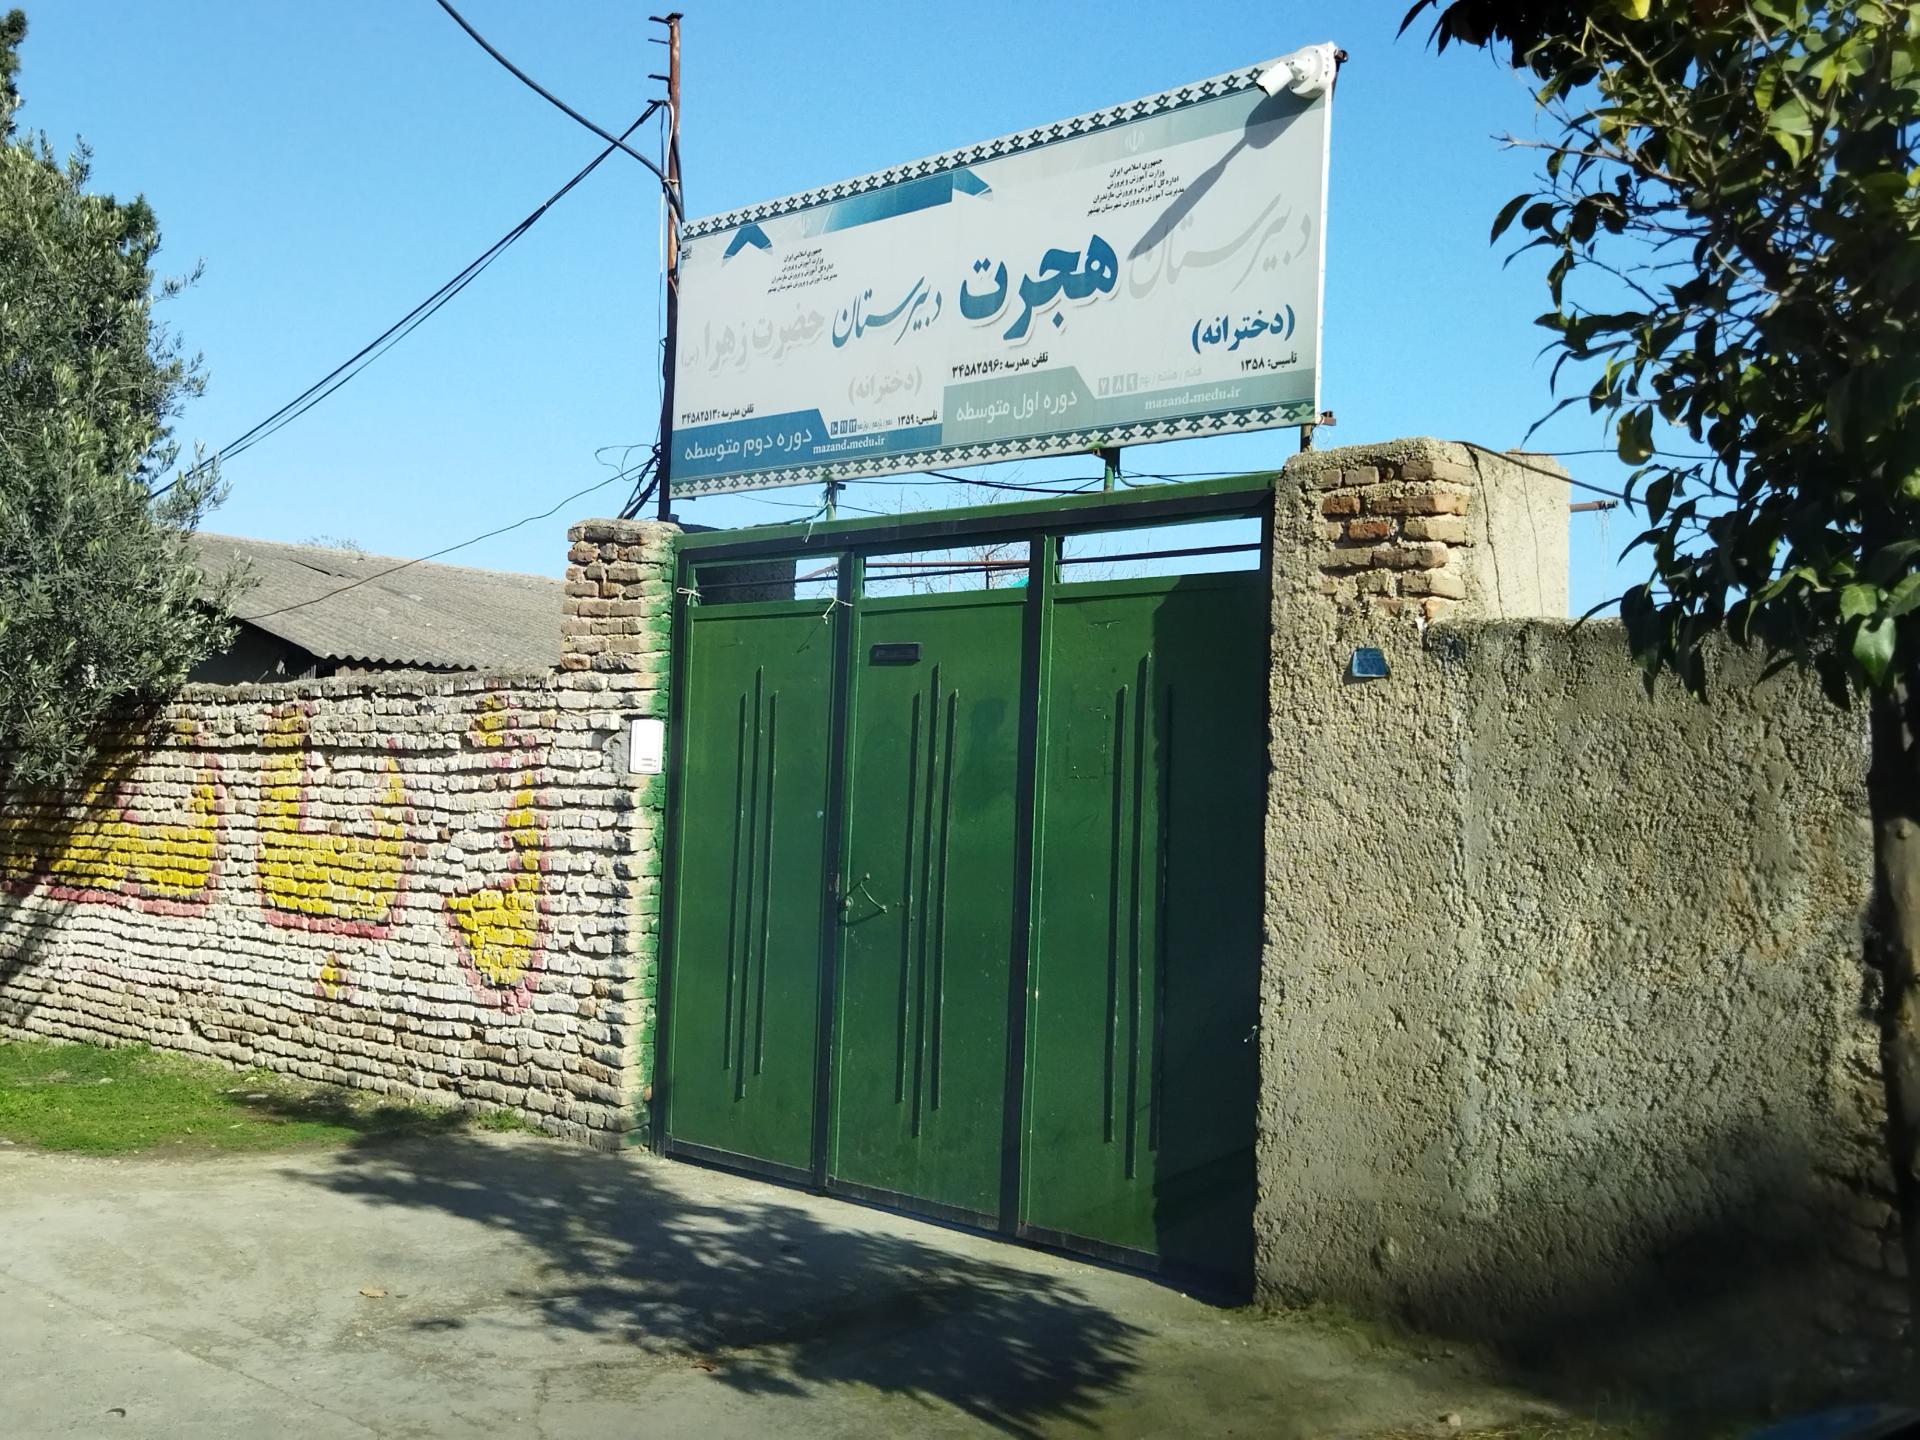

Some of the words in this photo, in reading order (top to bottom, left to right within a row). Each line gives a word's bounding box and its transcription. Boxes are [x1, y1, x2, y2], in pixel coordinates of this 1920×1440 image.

[1109, 167, 1123, 178] ایران
[1123, 163, 1141, 174] اسلامی
[1148, 170, 1165, 178] وزارت
[1107, 179, 1124, 189] پرورش
[1129, 171, 1147, 184] آموزش
[1115, 188, 1133, 198] پرورش
[1138, 180, 1156, 193] آموزش
[1165, 187, 1184, 196] مدیریت
[1092, 192, 1114, 203] مازندران
[1122, 198, 1140, 208] پرورش
[1145, 189, 1163, 202] آموزش
[1101, 203, 1121, 213] شهرستان
[1128, 193, 1311, 299] دبیرستان
[959, 234, 1119, 341] هجرت
[832, 276, 942, 348] دبیرستان
[751, 304, 825, 360] حضرت
[1192, 304, 1295, 354] (دخترانه)
[704, 319, 747, 372] زهرا
[1005, 357, 1030, 371] مدرسه
[1031, 352, 1048, 368] تلفن
[1240, 356, 1265, 371] ۱۳۵۸
[848, 366, 922, 404] (دخترانه)
[1013, 391, 1039, 419] اول
[1043, 389, 1078, 415] دوره
[1144, 386, 1242, 411] mazand.medu.ir
[741, 403, 754, 417] تلفن
[956, 399, 1010, 424] متوسطه
[897, 413, 914, 426] ۱۳۵۹
[743, 435, 773, 458] دوم
[777, 428, 812, 452] دوره
[812, 435, 885, 454] mazand.medu.ir
[684, 438, 740, 462] متوسطه
